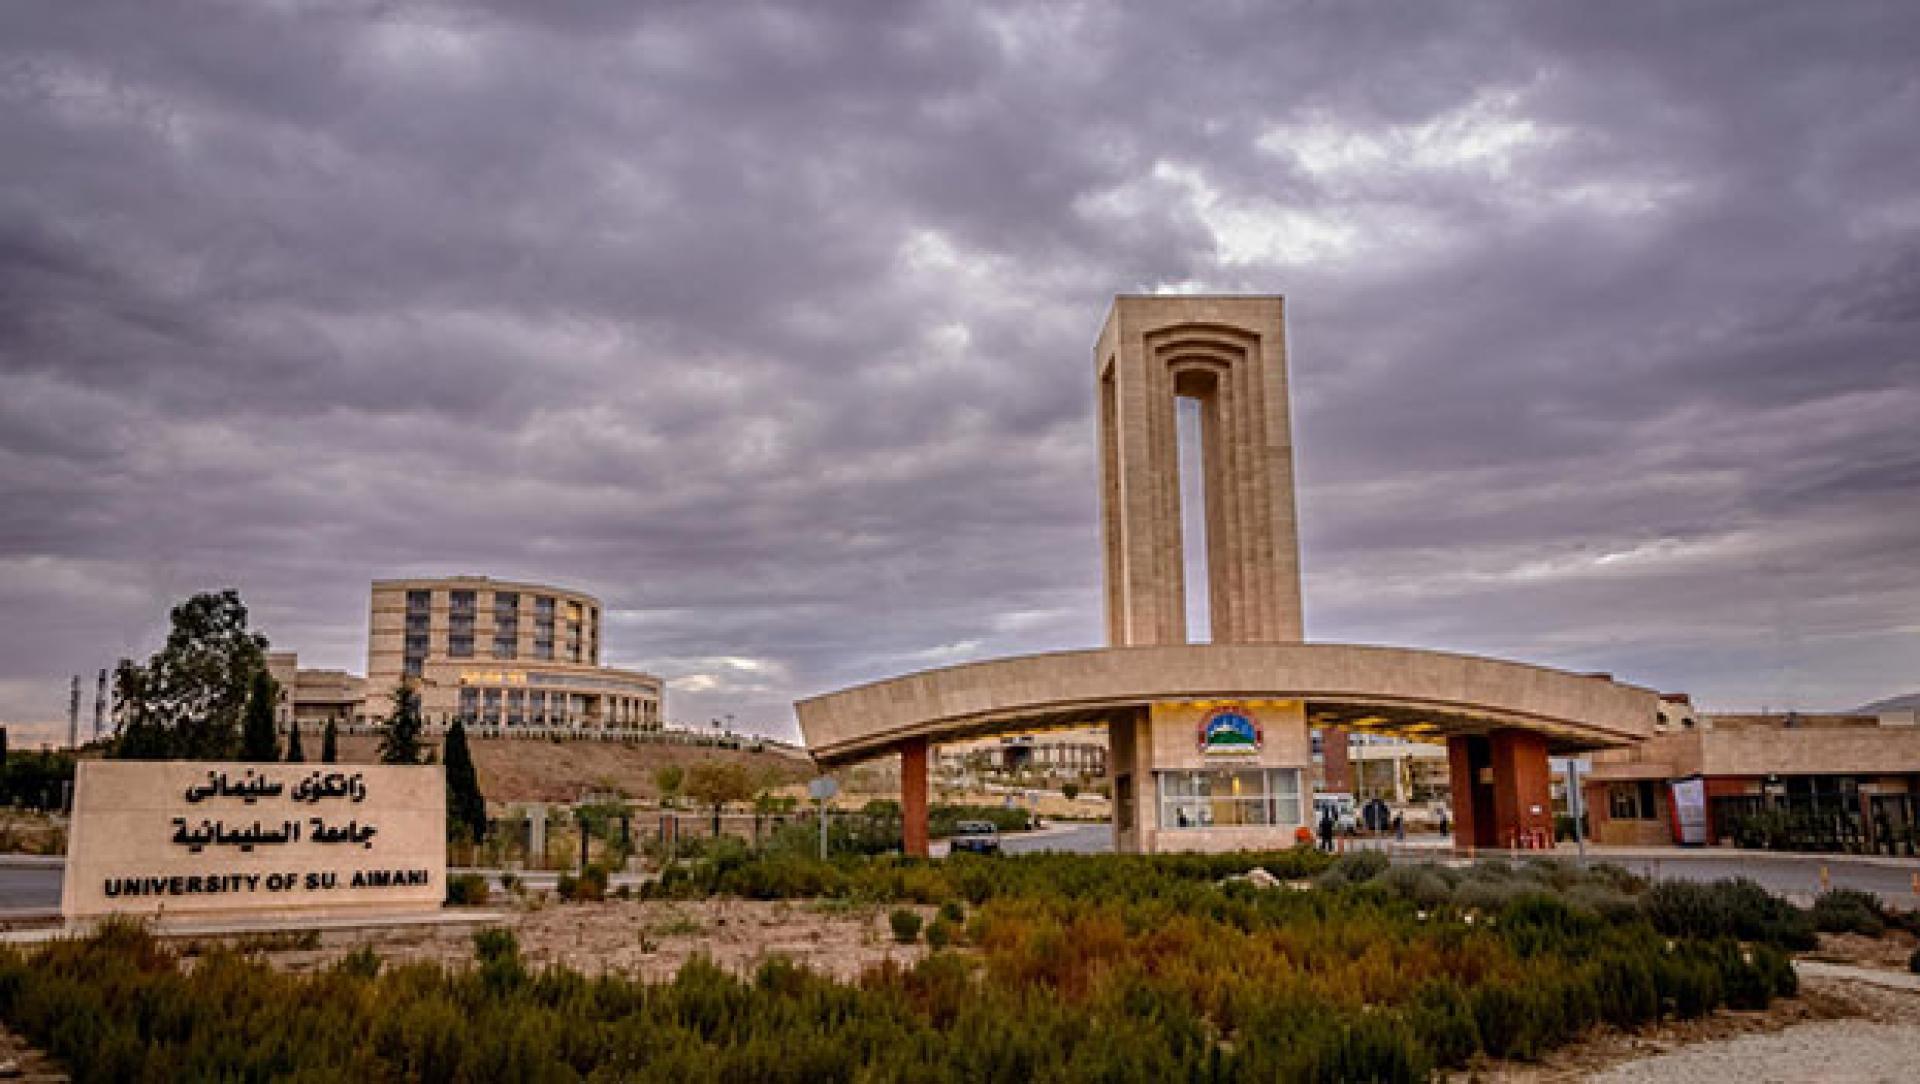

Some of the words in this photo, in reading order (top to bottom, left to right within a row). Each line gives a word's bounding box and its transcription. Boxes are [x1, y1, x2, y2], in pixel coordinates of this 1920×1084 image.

[172, 817, 301, 853] السليمانية
[310, 817, 378, 850] جامعة
[104, 872, 260, 899] UNIVERSITY
[265, 872, 298, 893] OF
